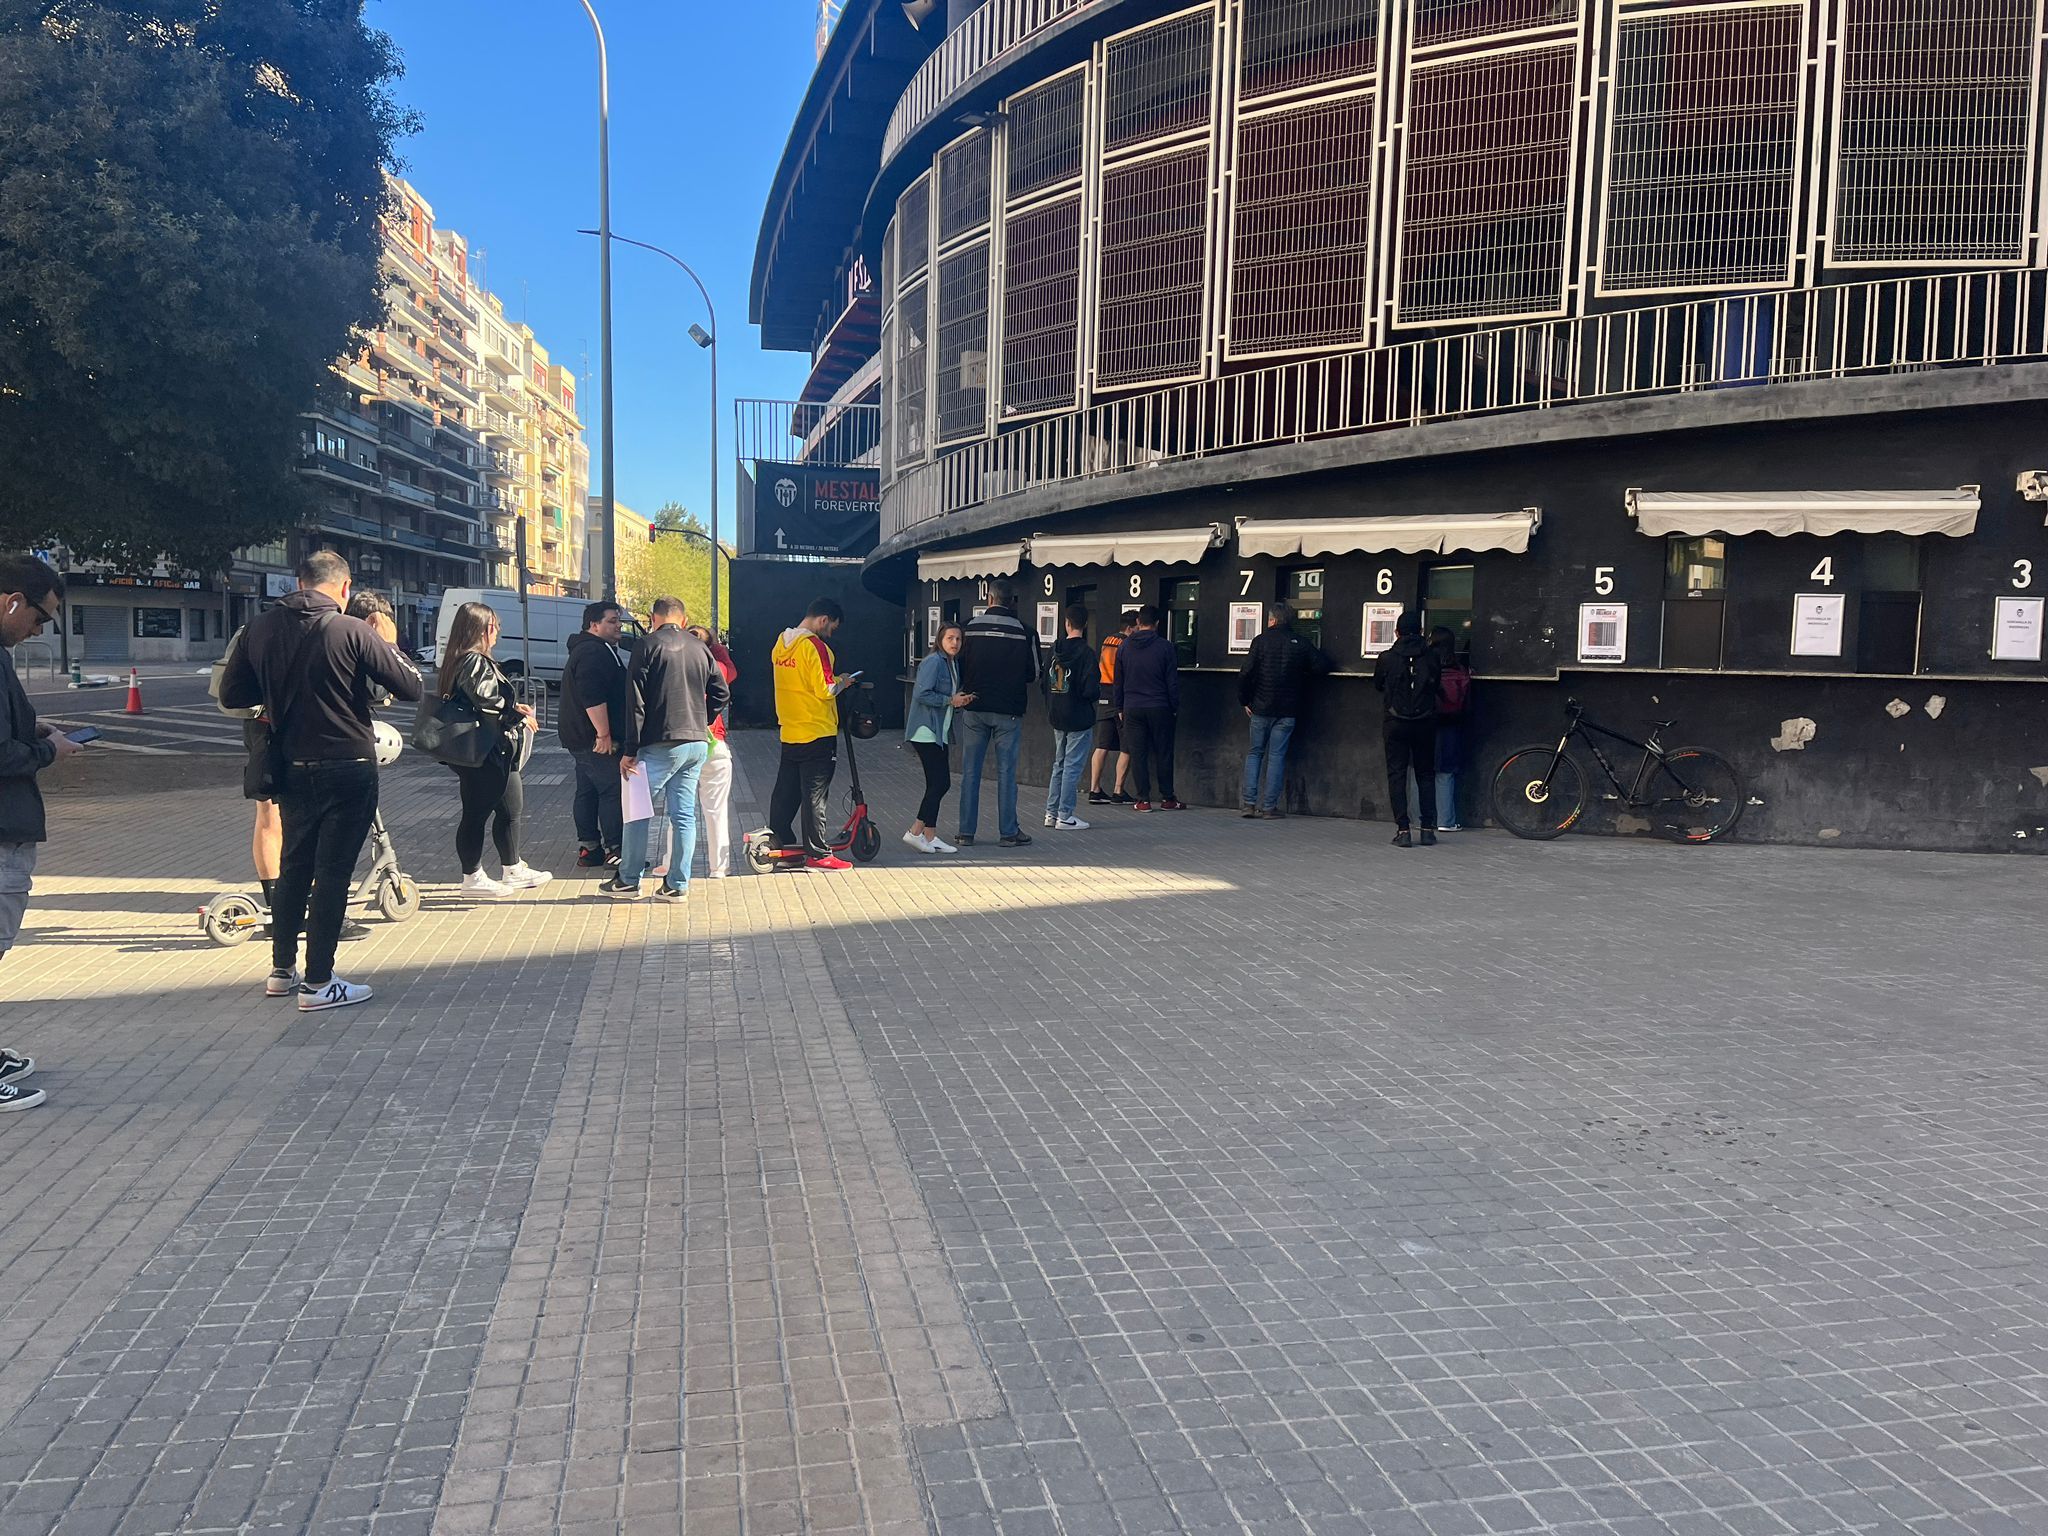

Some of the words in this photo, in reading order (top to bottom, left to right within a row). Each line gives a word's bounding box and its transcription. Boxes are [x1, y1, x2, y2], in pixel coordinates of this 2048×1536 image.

[815, 479, 880, 500] MESTAL
[1239, 570, 1255, 596] 7
[1376, 568, 1393, 595] 6
[1594, 566, 1615, 596] 5
[1810, 557, 1835, 586] 4
[2011, 559, 2032, 589] 3
[932, 582, 939, 602] 11
[977, 580, 988, 601] 10
[1043, 573, 1054, 597] 9
[1129, 574, 1142, 598] 8
